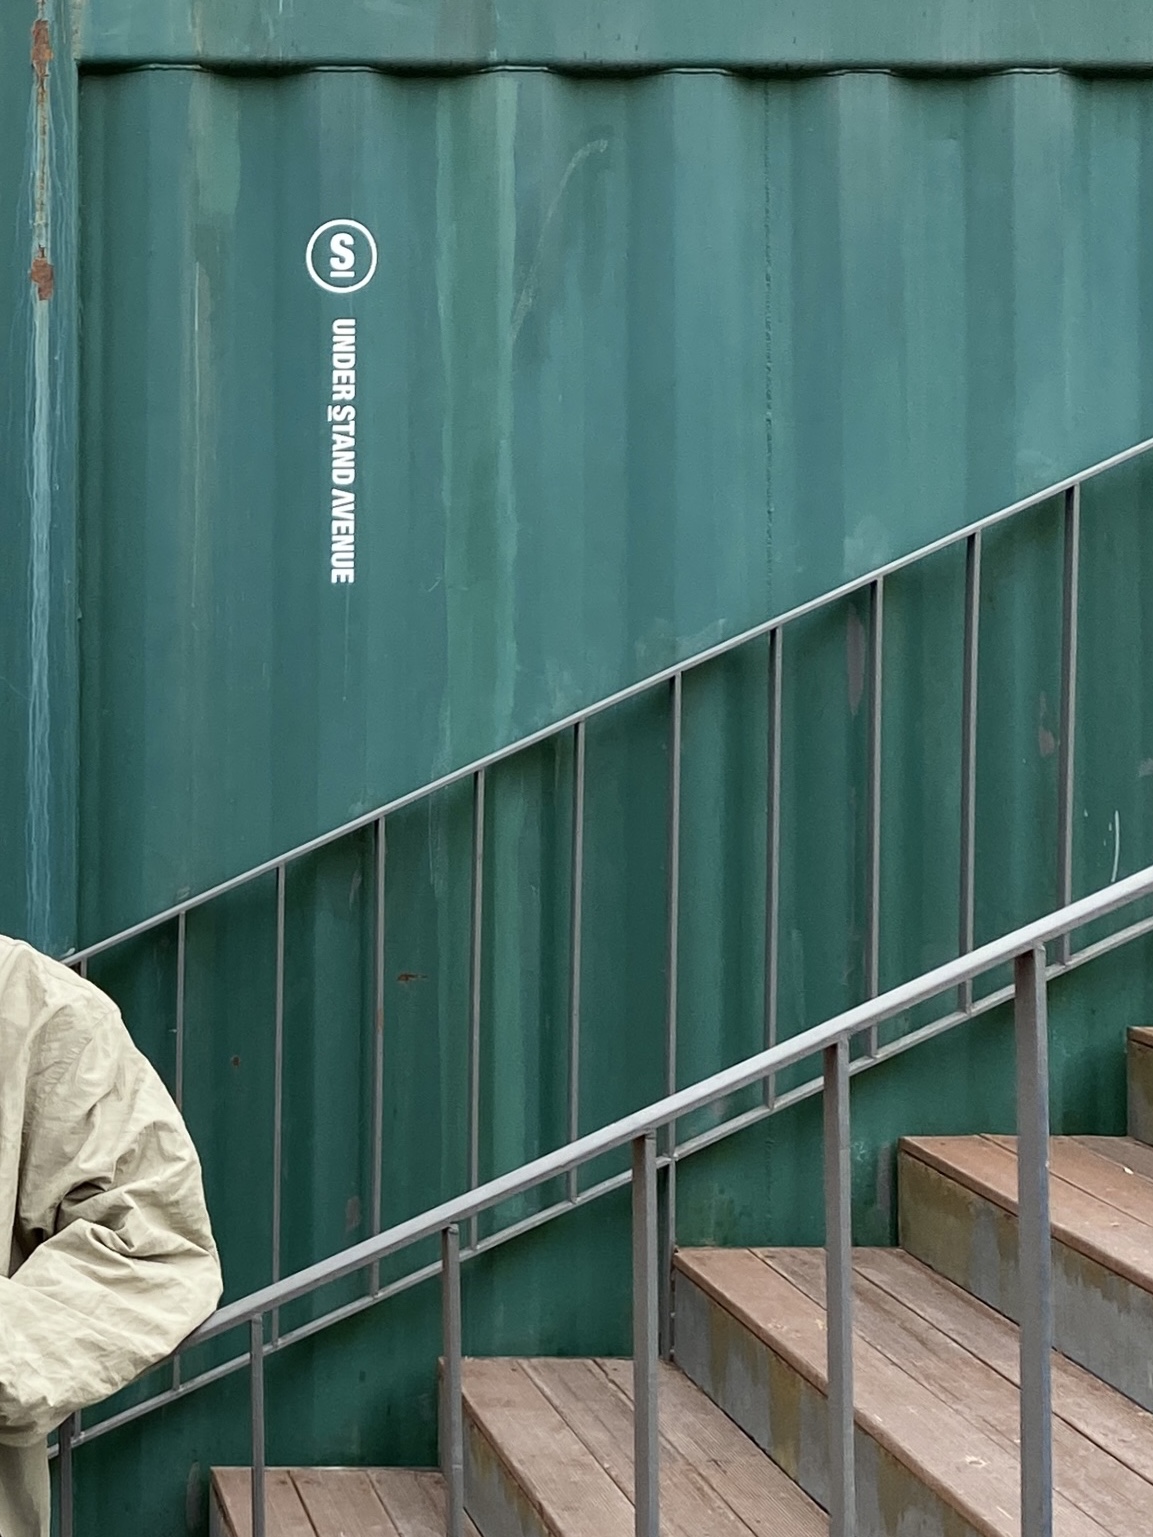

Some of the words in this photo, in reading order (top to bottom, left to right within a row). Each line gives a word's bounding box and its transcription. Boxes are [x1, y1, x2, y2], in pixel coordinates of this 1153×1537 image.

[329, 232, 356, 278] S
[332, 318, 356, 401] UNDER
[328, 405, 356, 485] STAND
[331, 488, 355, 584] AVENUE
